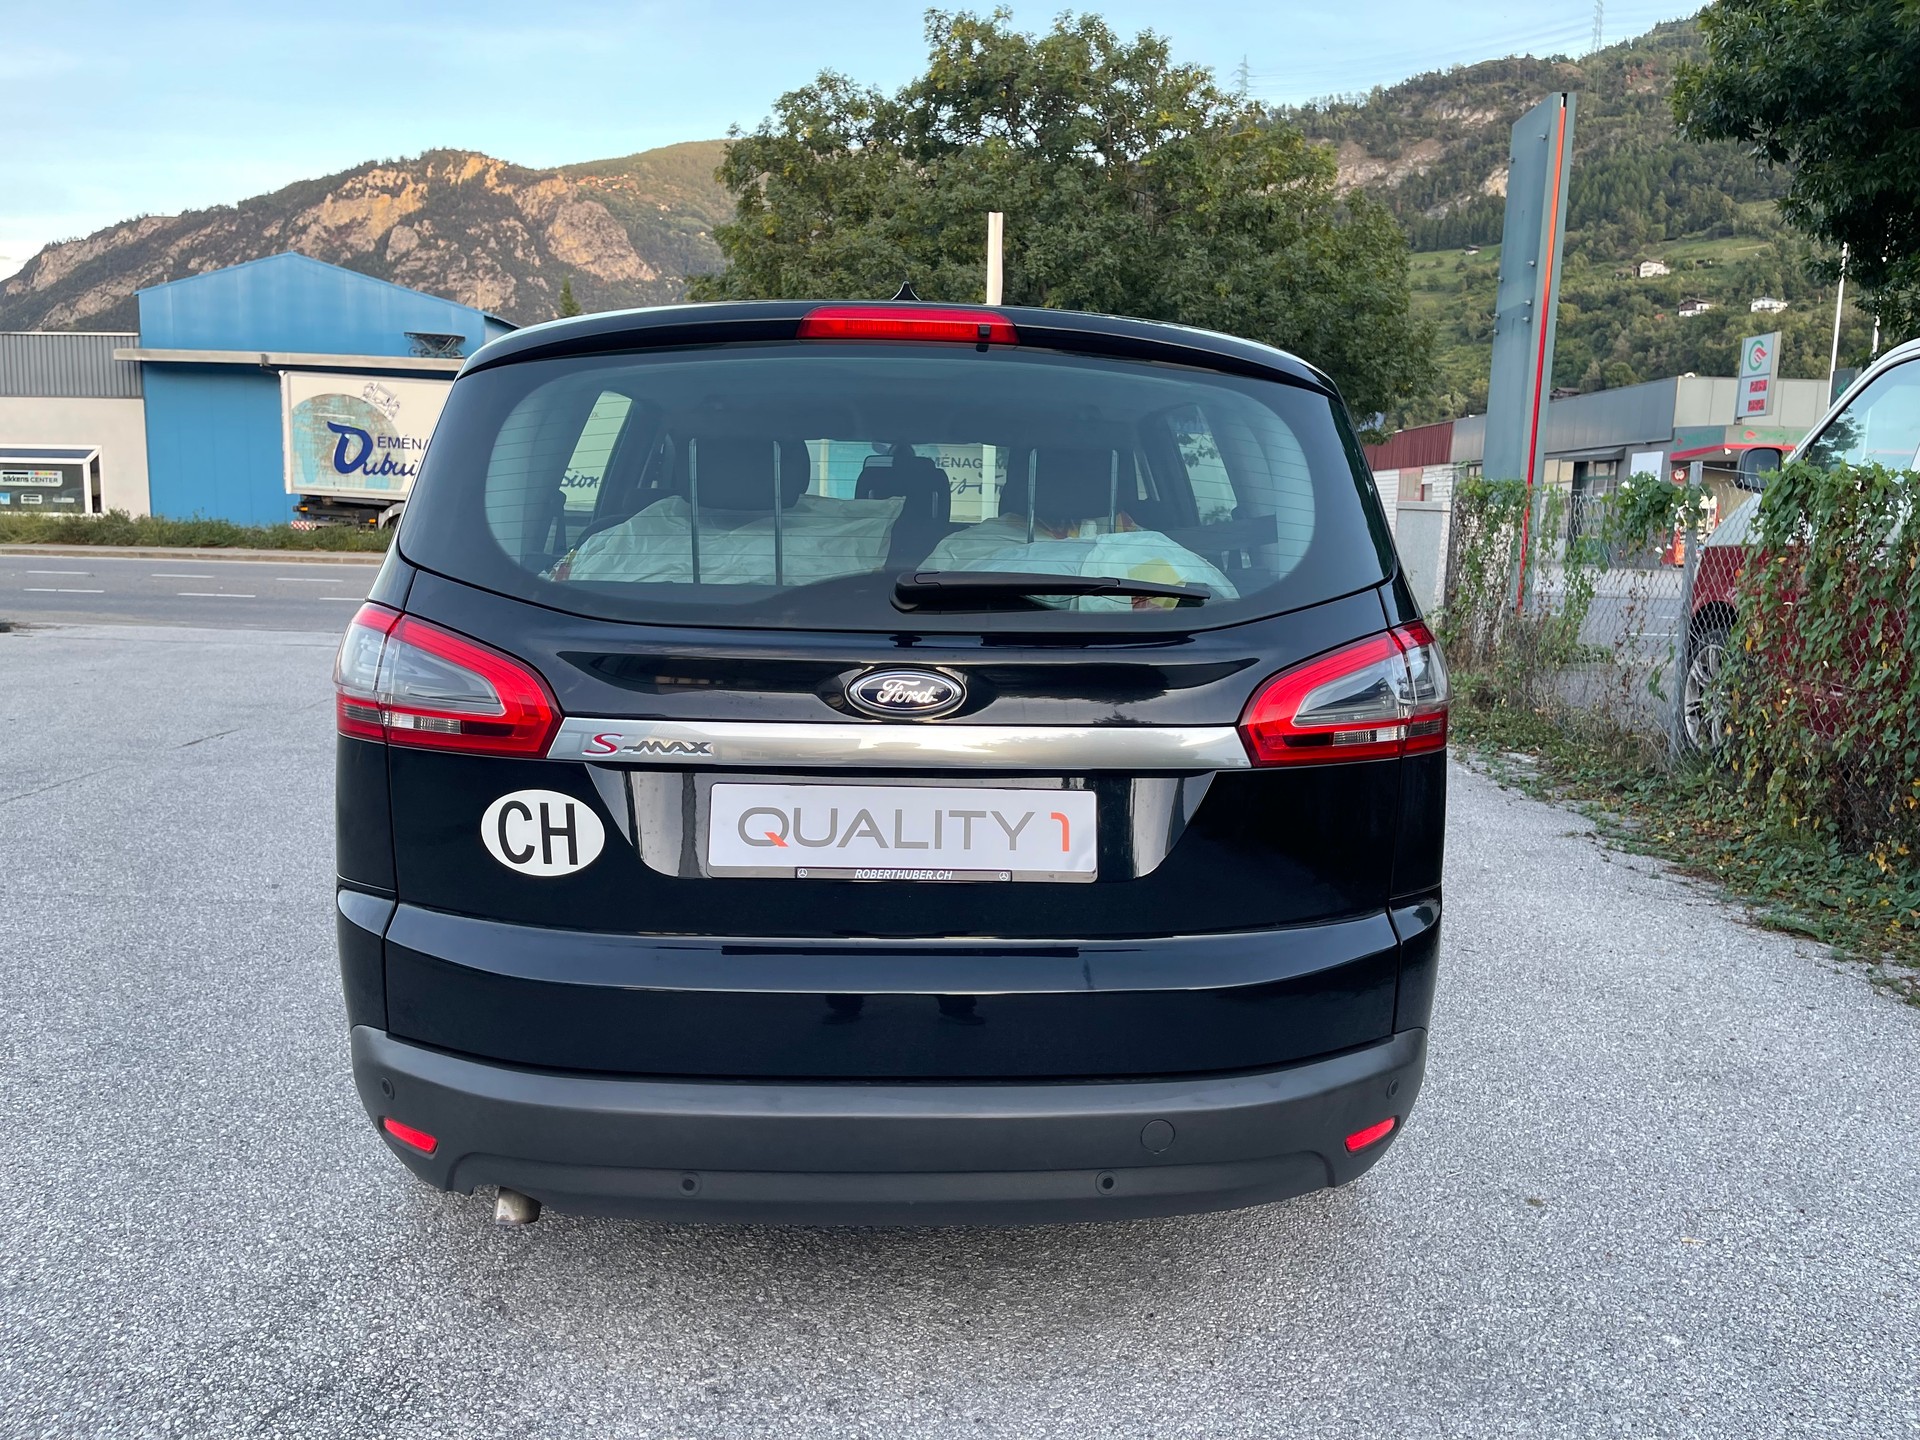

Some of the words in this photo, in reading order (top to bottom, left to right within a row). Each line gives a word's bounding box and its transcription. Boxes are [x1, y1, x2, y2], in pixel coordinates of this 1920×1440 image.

[327, 420, 419, 476] Dubui
[30, 476, 58, 484] CENTER
[876, 679, 939, 704] Ford
[582, 732, 713, 757] S-MAX
[497, 800, 580, 866] CH
[737, 806, 1036, 851] QUALITY
[1049, 811, 1071, 853] 1
[854, 868, 954, 881] ROBERTHUBER.CH
